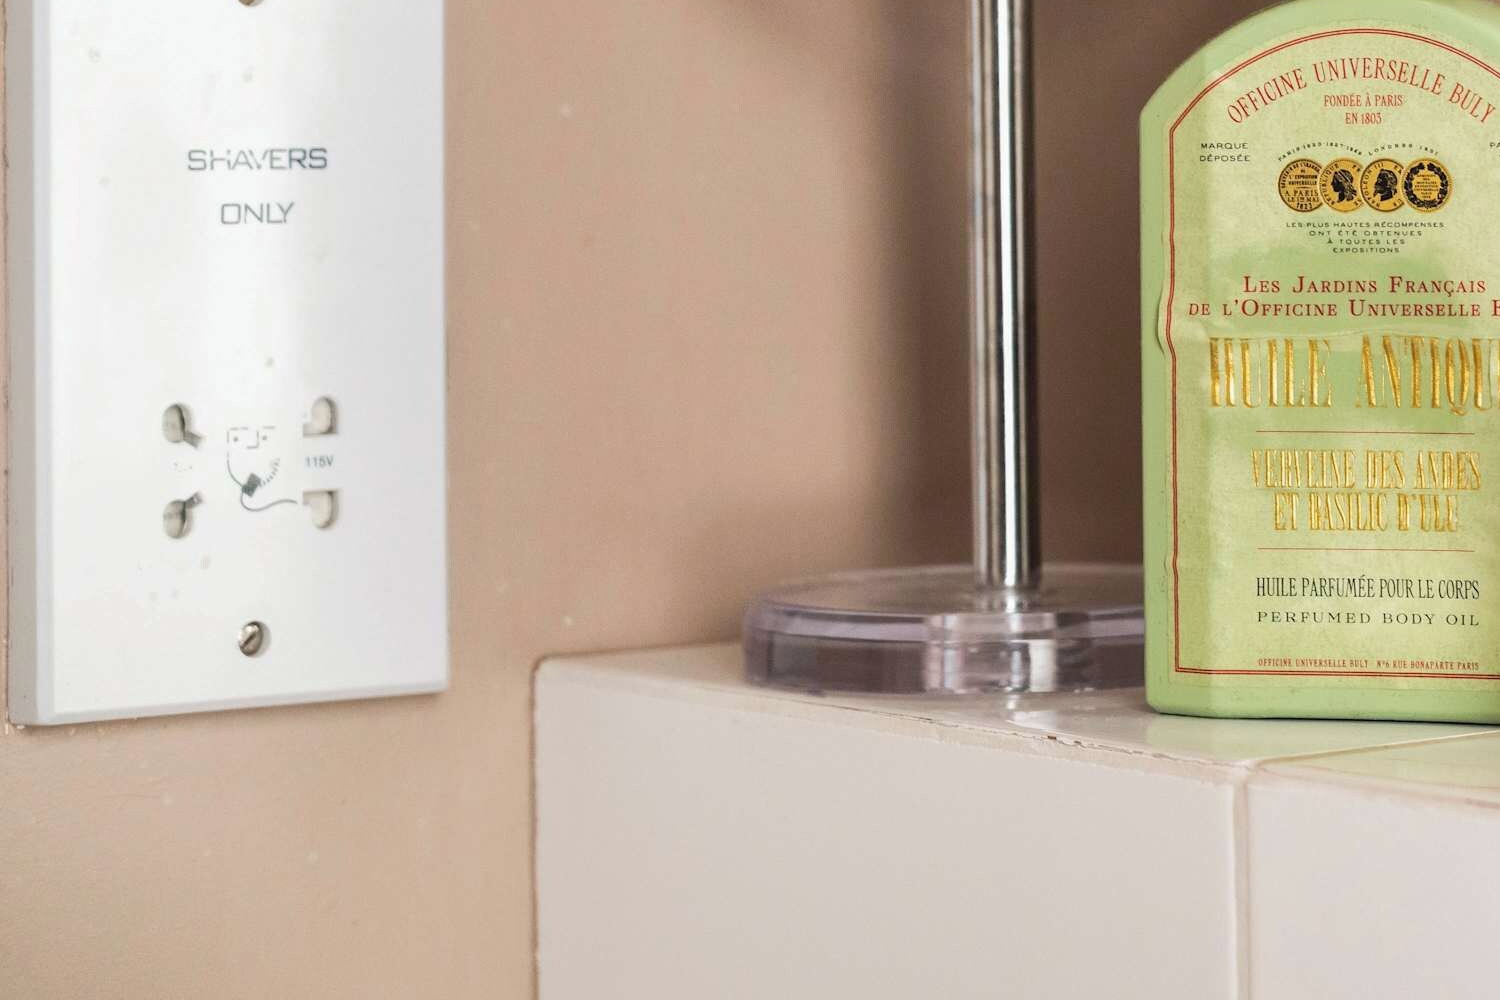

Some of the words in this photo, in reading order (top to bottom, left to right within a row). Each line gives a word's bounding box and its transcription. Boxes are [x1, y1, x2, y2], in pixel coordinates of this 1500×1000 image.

[1227, 68, 1307, 124] OFFICINE
[1312, 57, 1446, 96] UNIVERSELLE
[1449, 81, 1497, 124] BULY
[1323, 93, 1362, 108] FONDÉE
[1375, 95, 1404, 108] PARIS
[1345, 112, 1358, 124] EN
[1199, 153, 1251, 162] DÉPOSÉE
[1200, 142, 1249, 150] MARQUE
[187, 147, 328, 171] SHAVERS
[220, 202, 295, 225] ONLY
[1242, 275, 1281, 294] LES
[1293, 276, 1378, 294] JARDINS
[1388, 275, 1487, 298] FRANÇAIS
[1188, 304, 1211, 317] DE
[1223, 299, 1338, 317] L'OFFICINE
[1349, 299, 1482, 318] UNIVERSELLE
[1209, 337, 1333, 408] HUILE
[1251, 448, 1357, 490] VERVEINE
[1366, 449, 1407, 490] DES
[1414, 450, 1483, 491] ANDES
[1272, 491, 1299, 531] ET
[1308, 491, 1388, 532] BASILIC
[1256, 577, 1298, 598] HUILE
[1301, 574, 1376, 599] PARFUMÉE
[1379, 577, 1415, 600] POUR
[1418, 578, 1435, 600] LE
[1438, 578, 1480, 601] CORPS
[1257, 611, 1371, 625] PERFUMED
[1383, 612, 1436, 626] BODY
[1446, 613, 1480, 627] OIL
[1258, 658, 1292, 667] OFFICINE
[1295, 659, 1347, 668] UNIVERSELLE
[1392, 660, 1407, 669] RUE
[1410, 661, 1454, 670] BONAPARTE
[1457, 662, 1480, 671] PARIS
